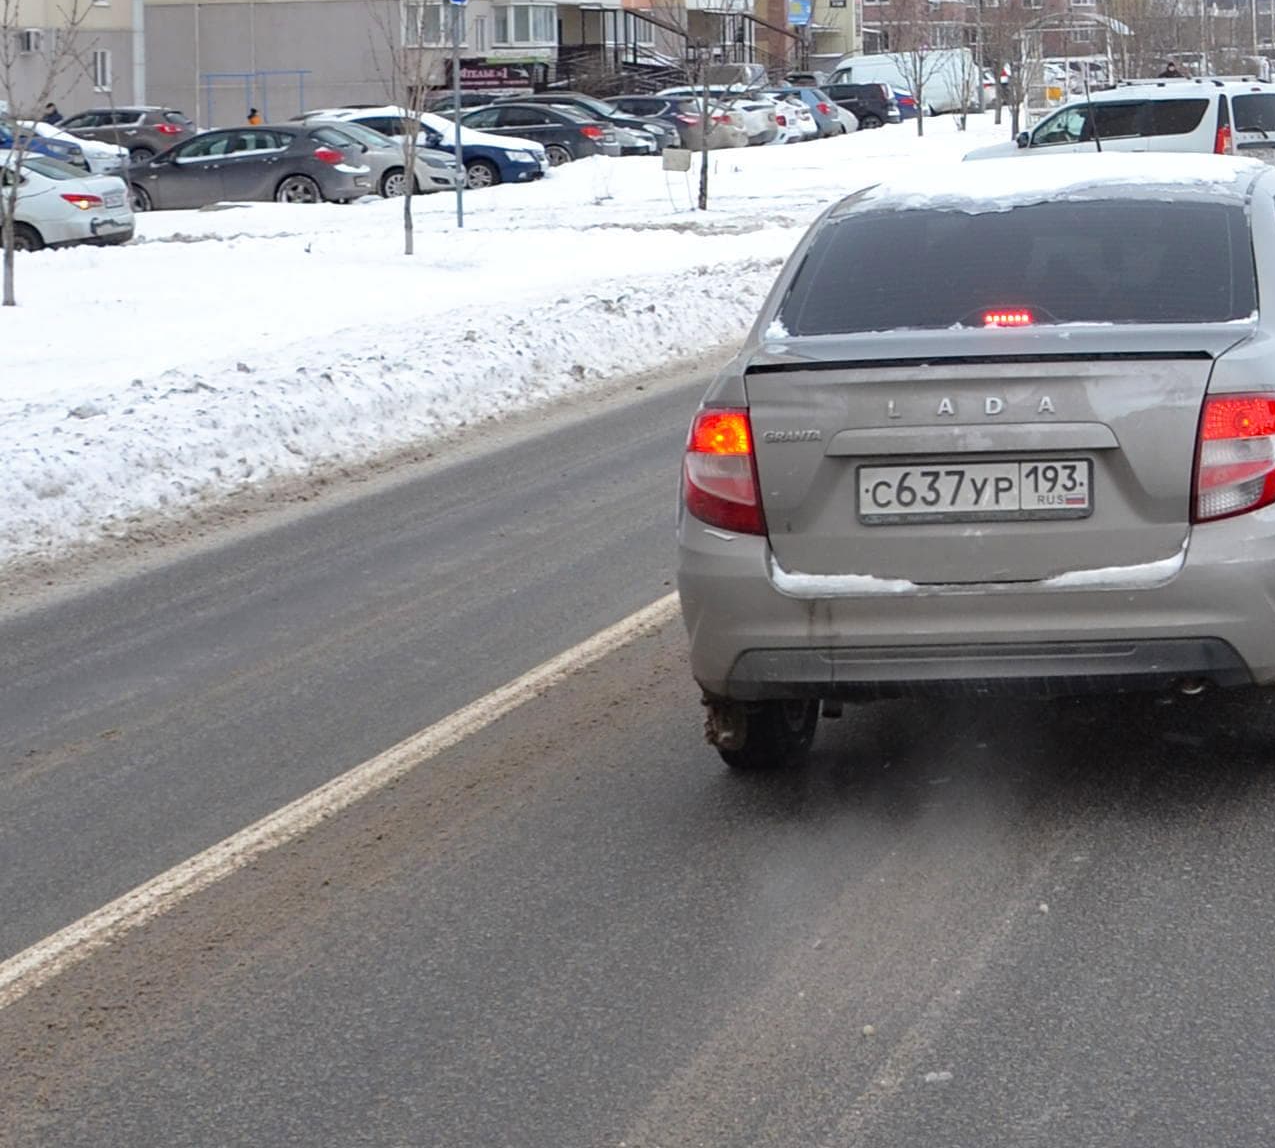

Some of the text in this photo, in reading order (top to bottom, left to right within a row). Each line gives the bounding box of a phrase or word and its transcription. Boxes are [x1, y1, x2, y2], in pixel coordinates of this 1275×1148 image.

[888, 395, 1055, 419] LADA
[763, 429, 822, 443] GRANTA
[871, 464, 1078, 508] С637УР 193
[1037, 495, 1064, 505] RUS
